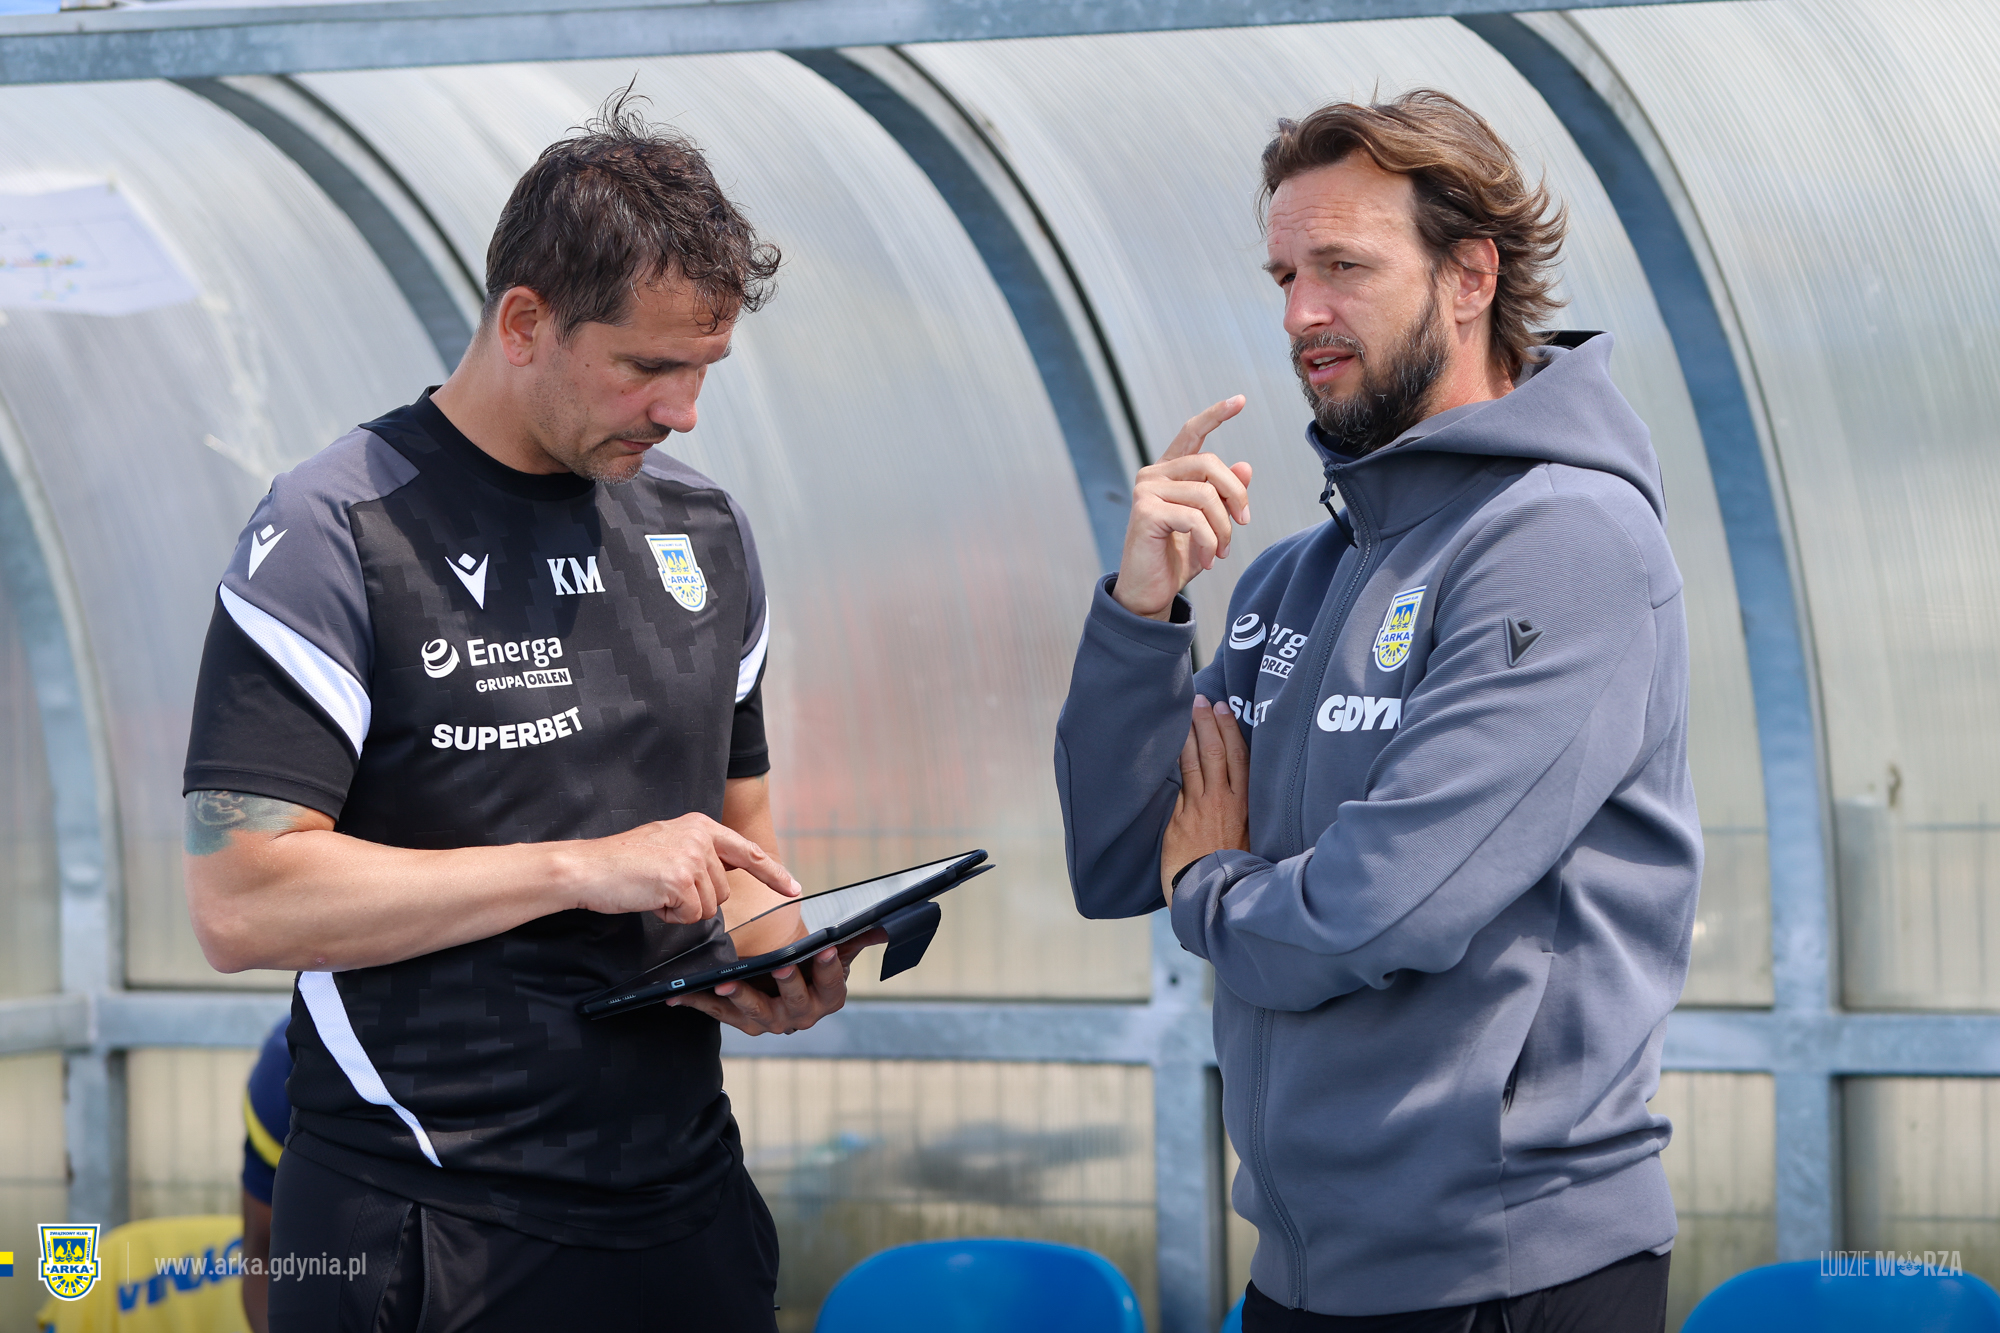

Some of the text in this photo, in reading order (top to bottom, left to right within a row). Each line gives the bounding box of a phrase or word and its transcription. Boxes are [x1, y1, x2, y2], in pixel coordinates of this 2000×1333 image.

[547, 555, 606, 596] KM
[671, 575, 698, 584] ARKA
[1382, 631, 1410, 643] ARKA
[467, 636, 563, 667] Energa
[1262, 658, 1291, 676] ORLE
[475, 671, 569, 693] GRUPA ORLEN
[431, 706, 583, 751] SUPERBET
